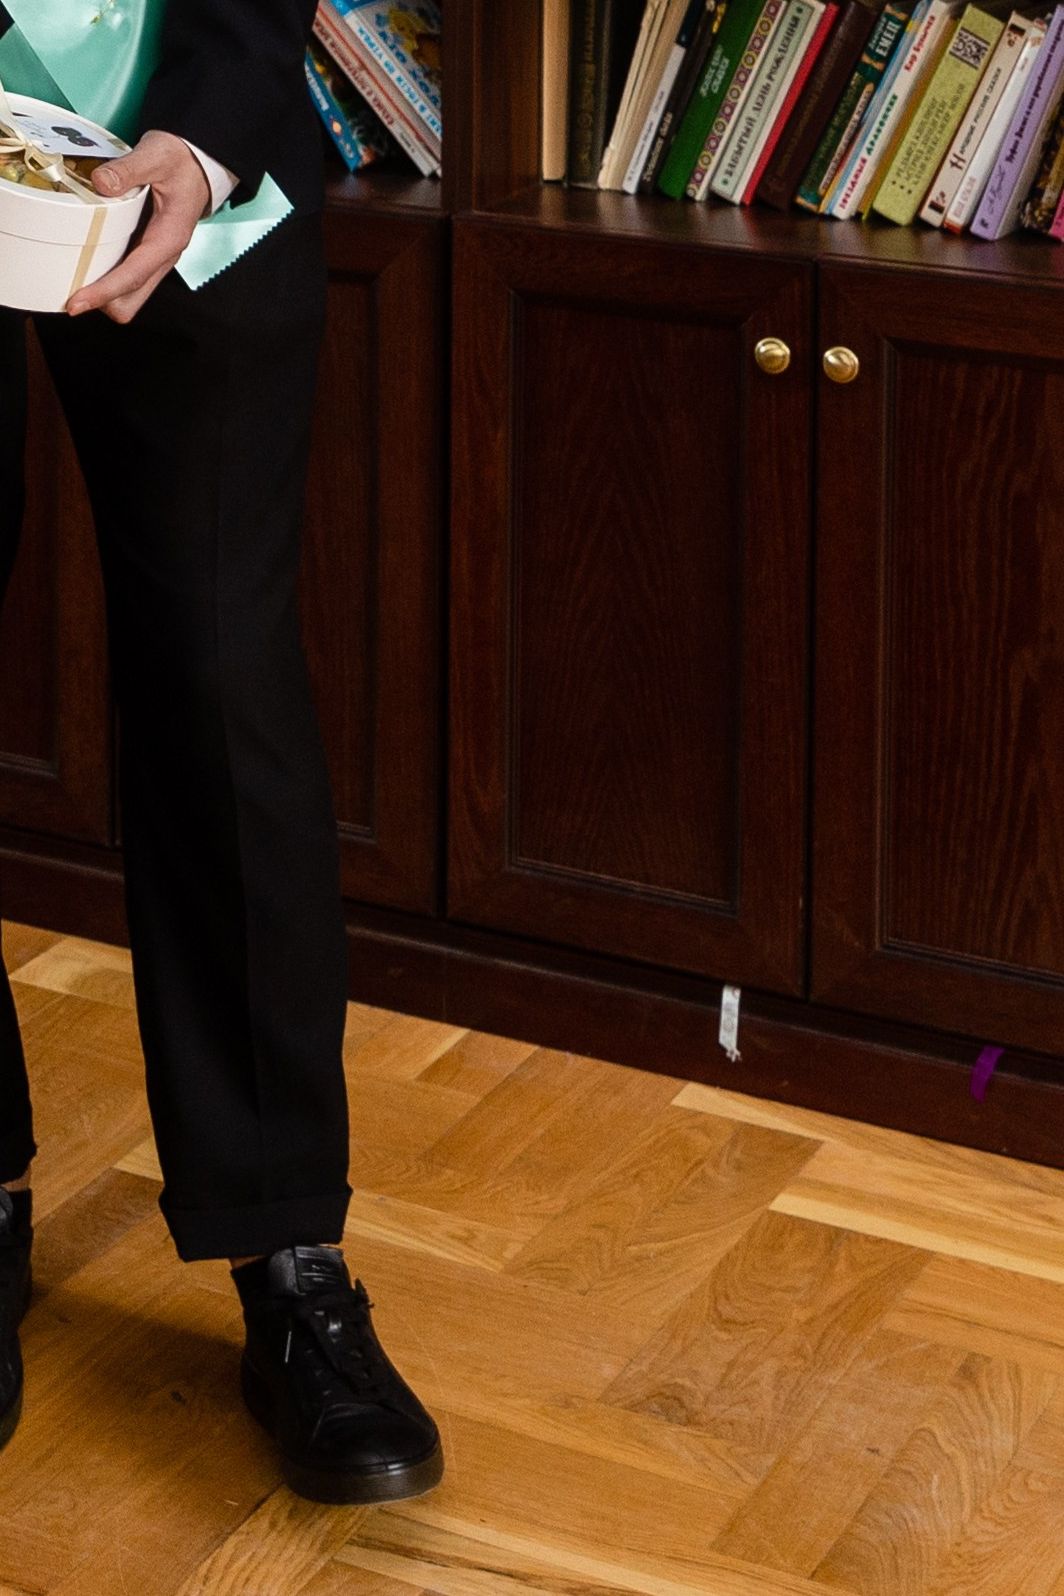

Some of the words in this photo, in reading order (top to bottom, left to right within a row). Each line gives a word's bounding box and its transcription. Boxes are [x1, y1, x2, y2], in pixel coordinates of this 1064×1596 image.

[875, 20, 900, 58] ЕМЕЦ
[904, 54, 918, 72] Кир
[912, 15, 936, 52] Булычев
[724, 117, 758, 178] ЗАБЫТЫЙ
[749, 82, 771, 114] ДЕНЬ
[765, 16, 801, 82] РОЖДЕНИЯ
[986, 68, 1002, 93] СКАЗКИ
[838, 158, 868, 210] ЗВЕЗДНЫЙ
[864, 94, 898, 156] ДРАКОНЧИК
